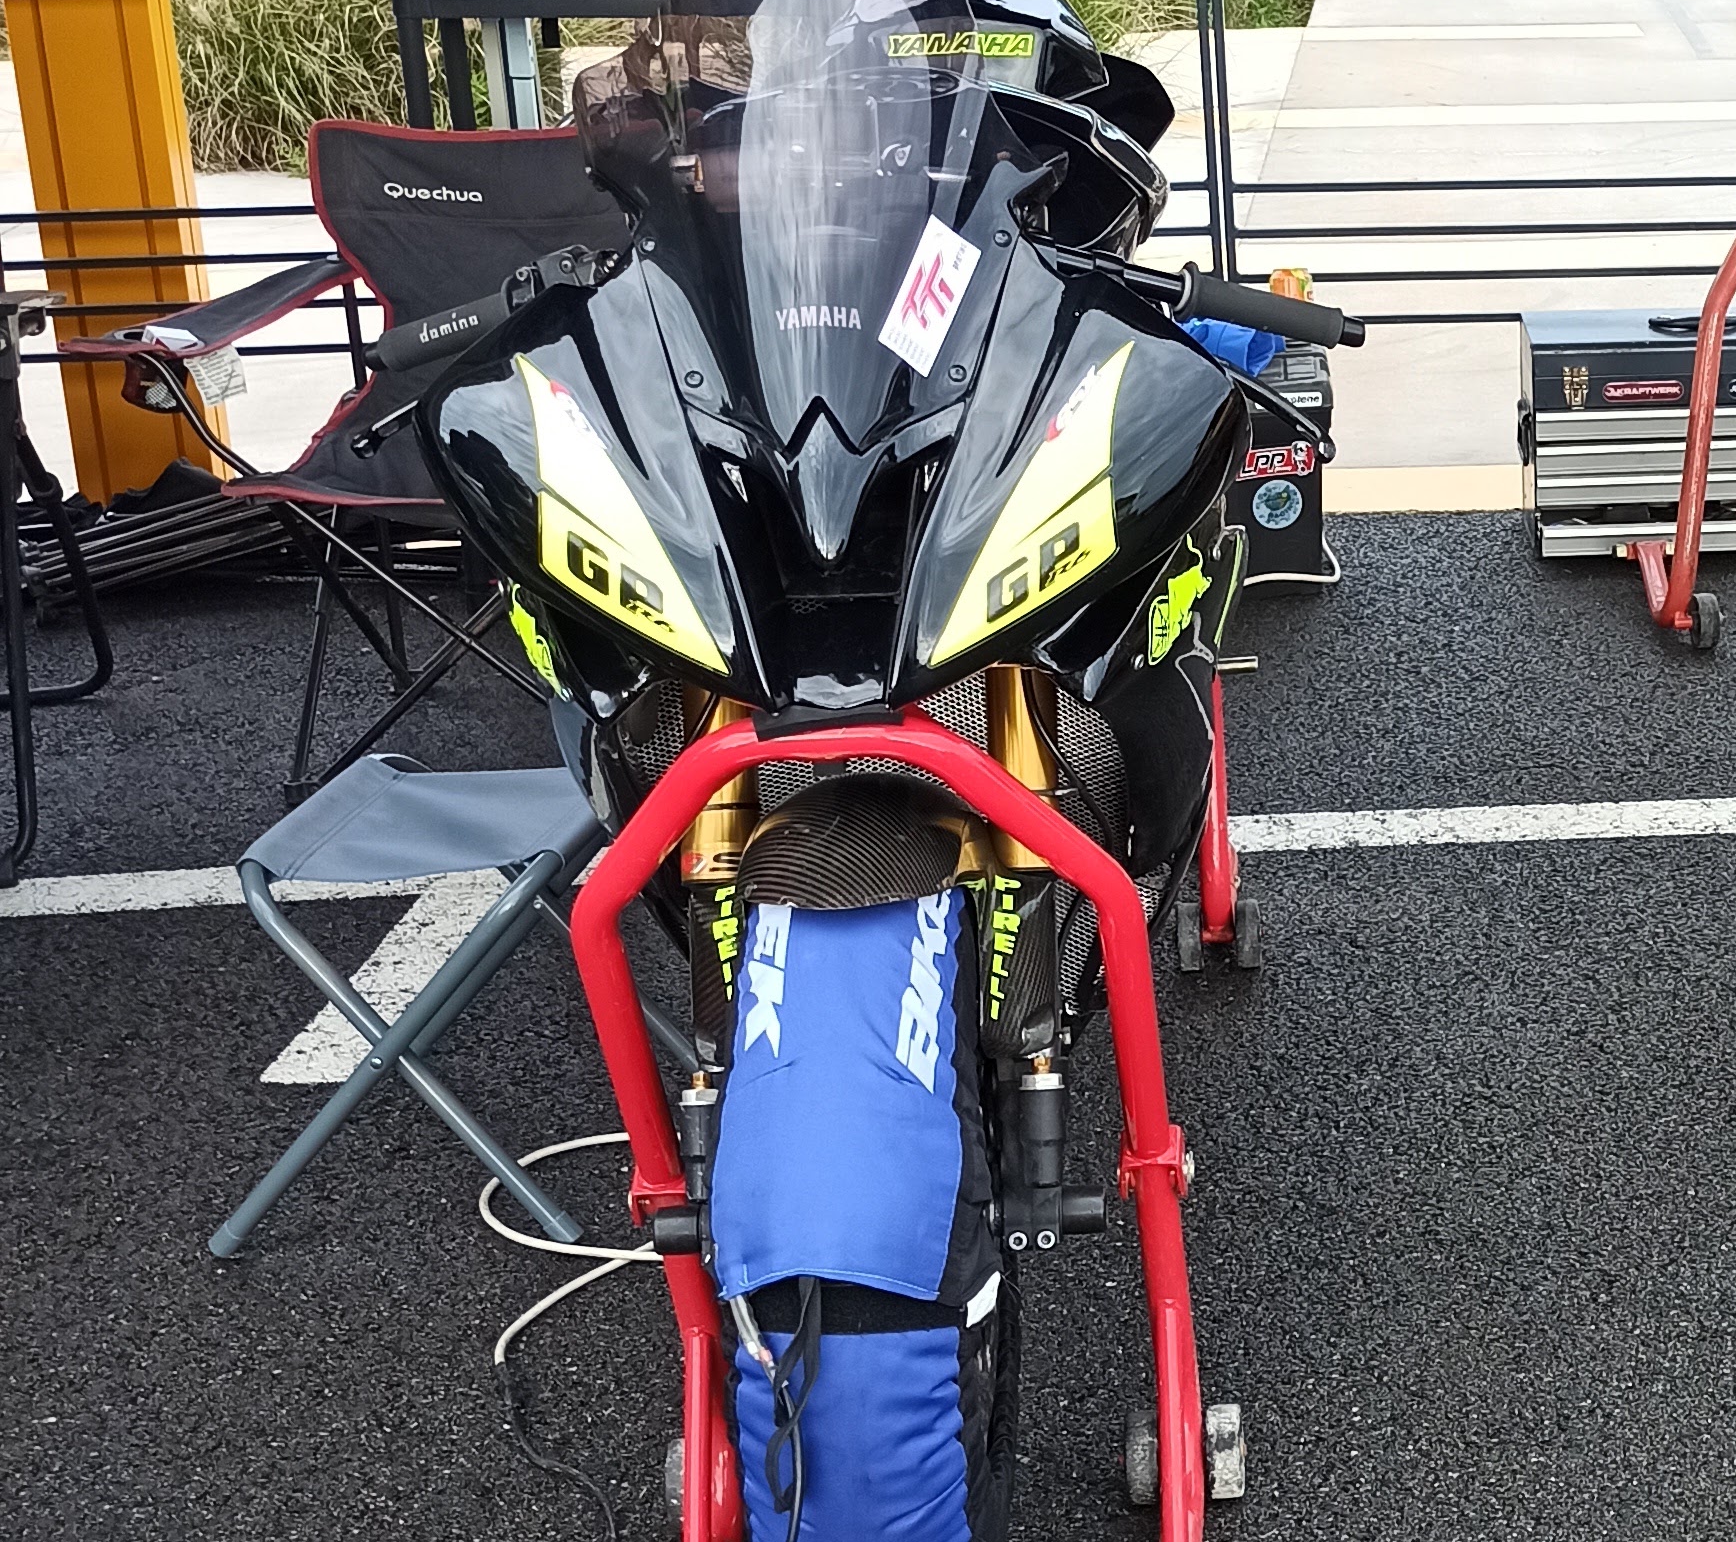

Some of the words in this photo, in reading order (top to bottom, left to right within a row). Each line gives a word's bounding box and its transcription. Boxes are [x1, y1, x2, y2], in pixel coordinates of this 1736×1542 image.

[888, 31, 1034, 57] YAMAHA
[383, 182, 484, 203] Quechua
[418, 312, 480, 344] domino
[775, 305, 862, 331] YAMAHA
[566, 530, 664, 615] GP
[986, 521, 1080, 624] GP
[989, 874, 1022, 1021] PIRELLI
